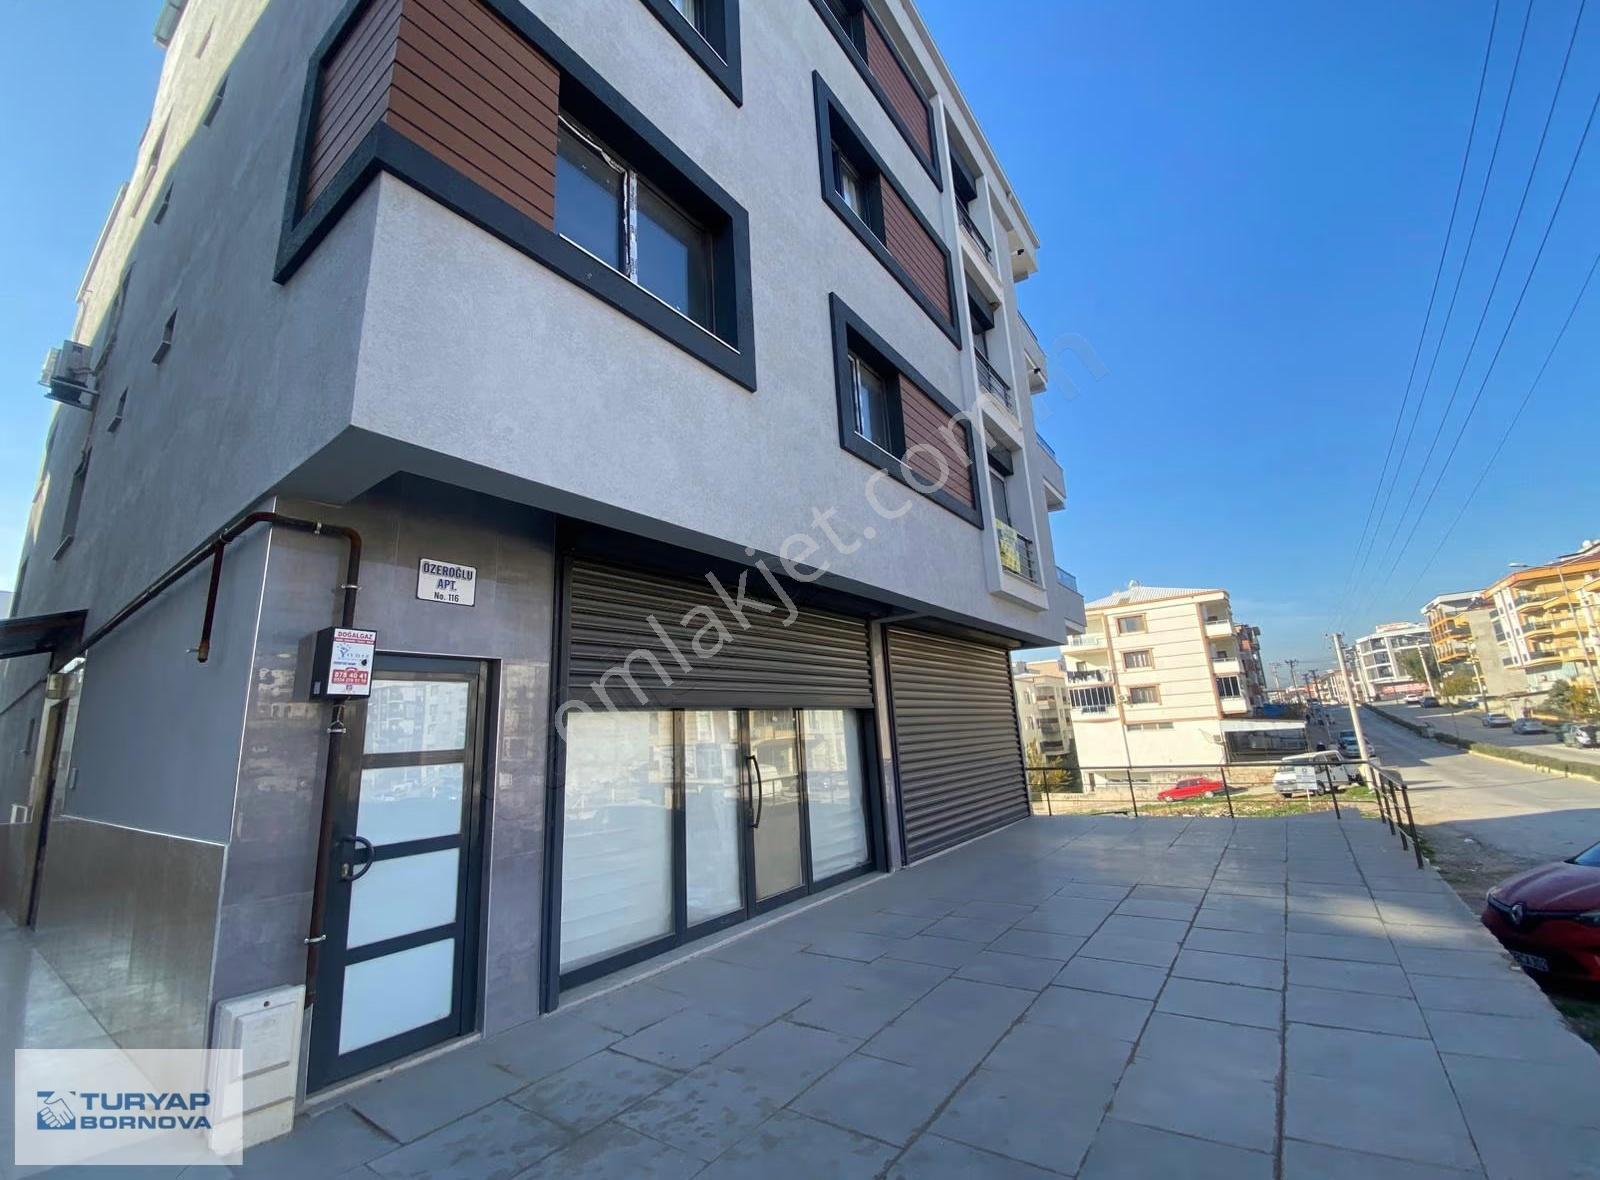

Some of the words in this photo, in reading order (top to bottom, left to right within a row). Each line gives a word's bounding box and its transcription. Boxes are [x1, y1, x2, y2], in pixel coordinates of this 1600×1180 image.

[437, 579, 457, 591] APT.
[434, 591, 446, 601] No.
[448, 594, 460, 602] 116
